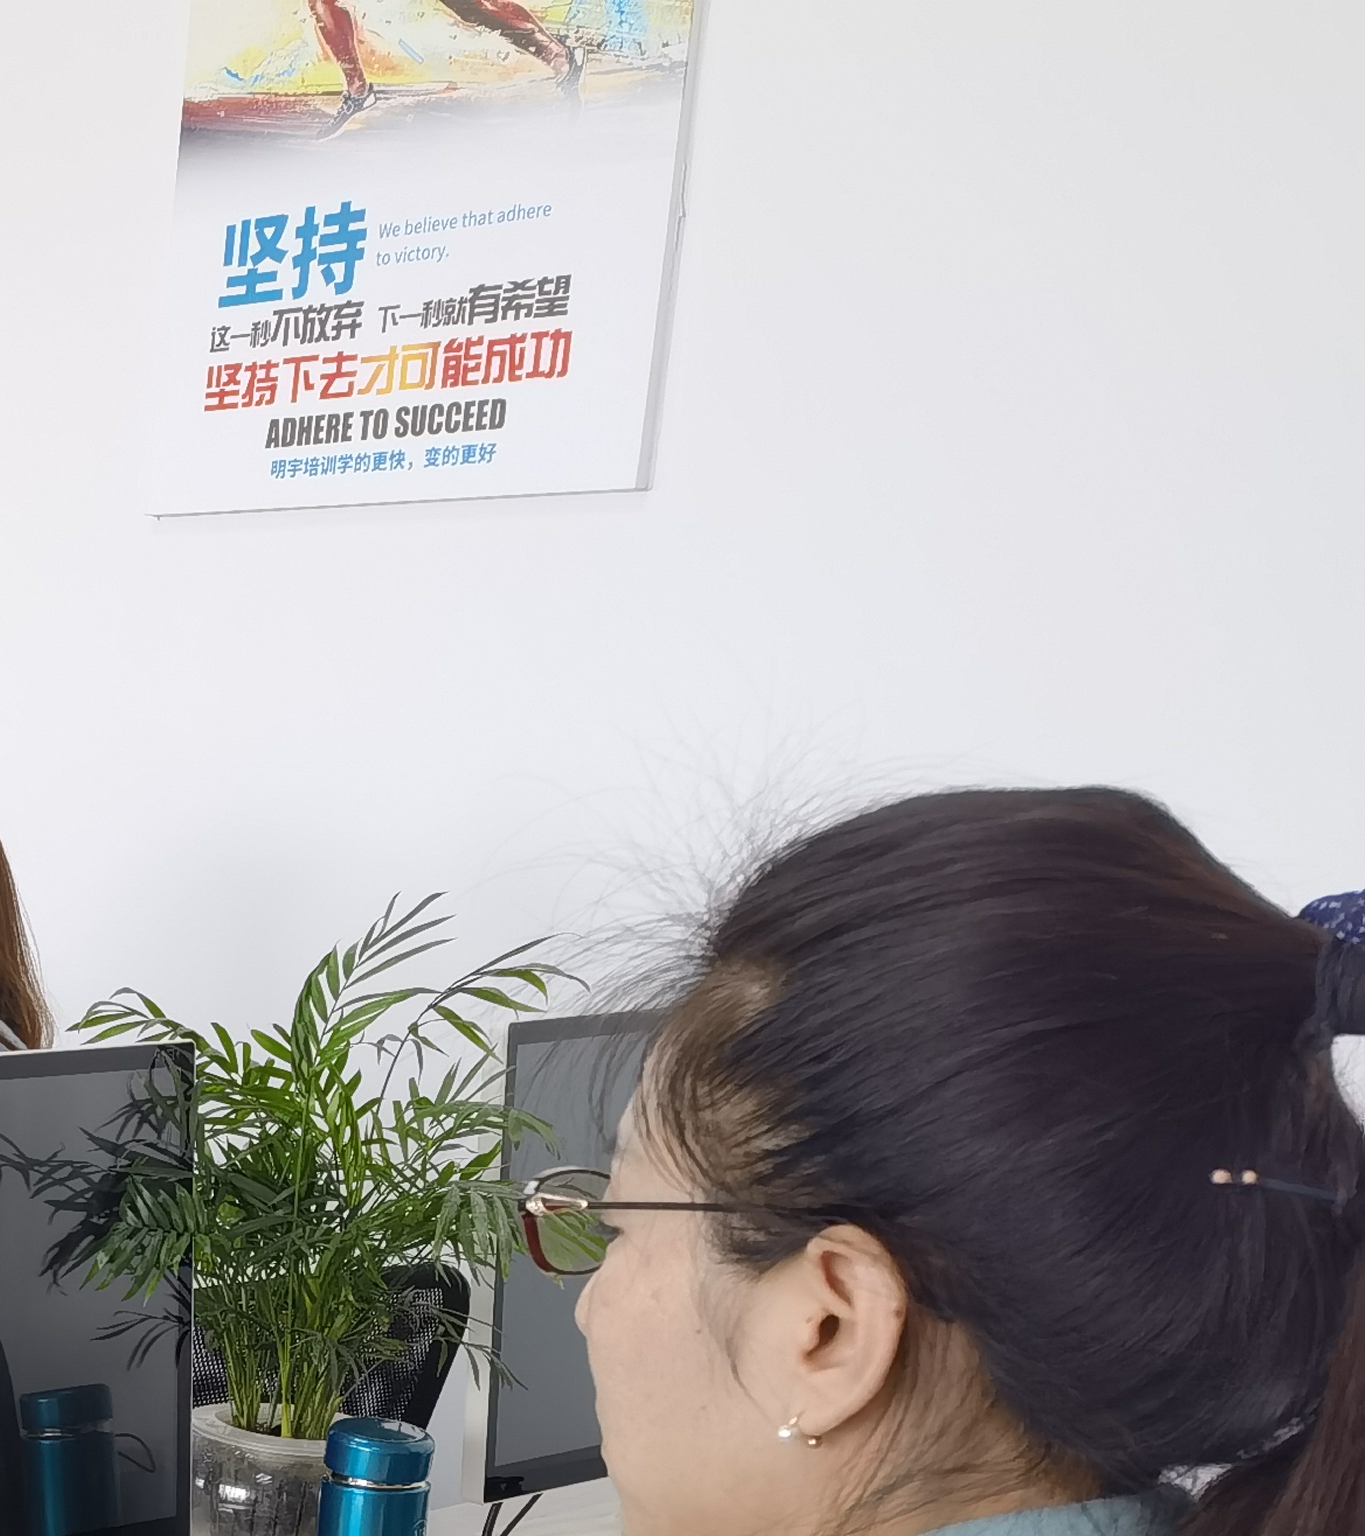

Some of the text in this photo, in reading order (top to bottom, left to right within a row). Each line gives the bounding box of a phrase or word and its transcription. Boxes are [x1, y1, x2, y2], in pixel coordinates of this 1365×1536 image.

[379, 202, 553, 239] We believe that adhere
[218, 200, 367, 309] 坚持
[375, 243, 451, 266] to victory.
[209, 274, 572, 353] 这一秒不放弃 下一秒就有希望
[203, 328, 573, 412] 坚持下去才可能成功
[265, 398, 507, 449] ADHERE TO SUCCEED
